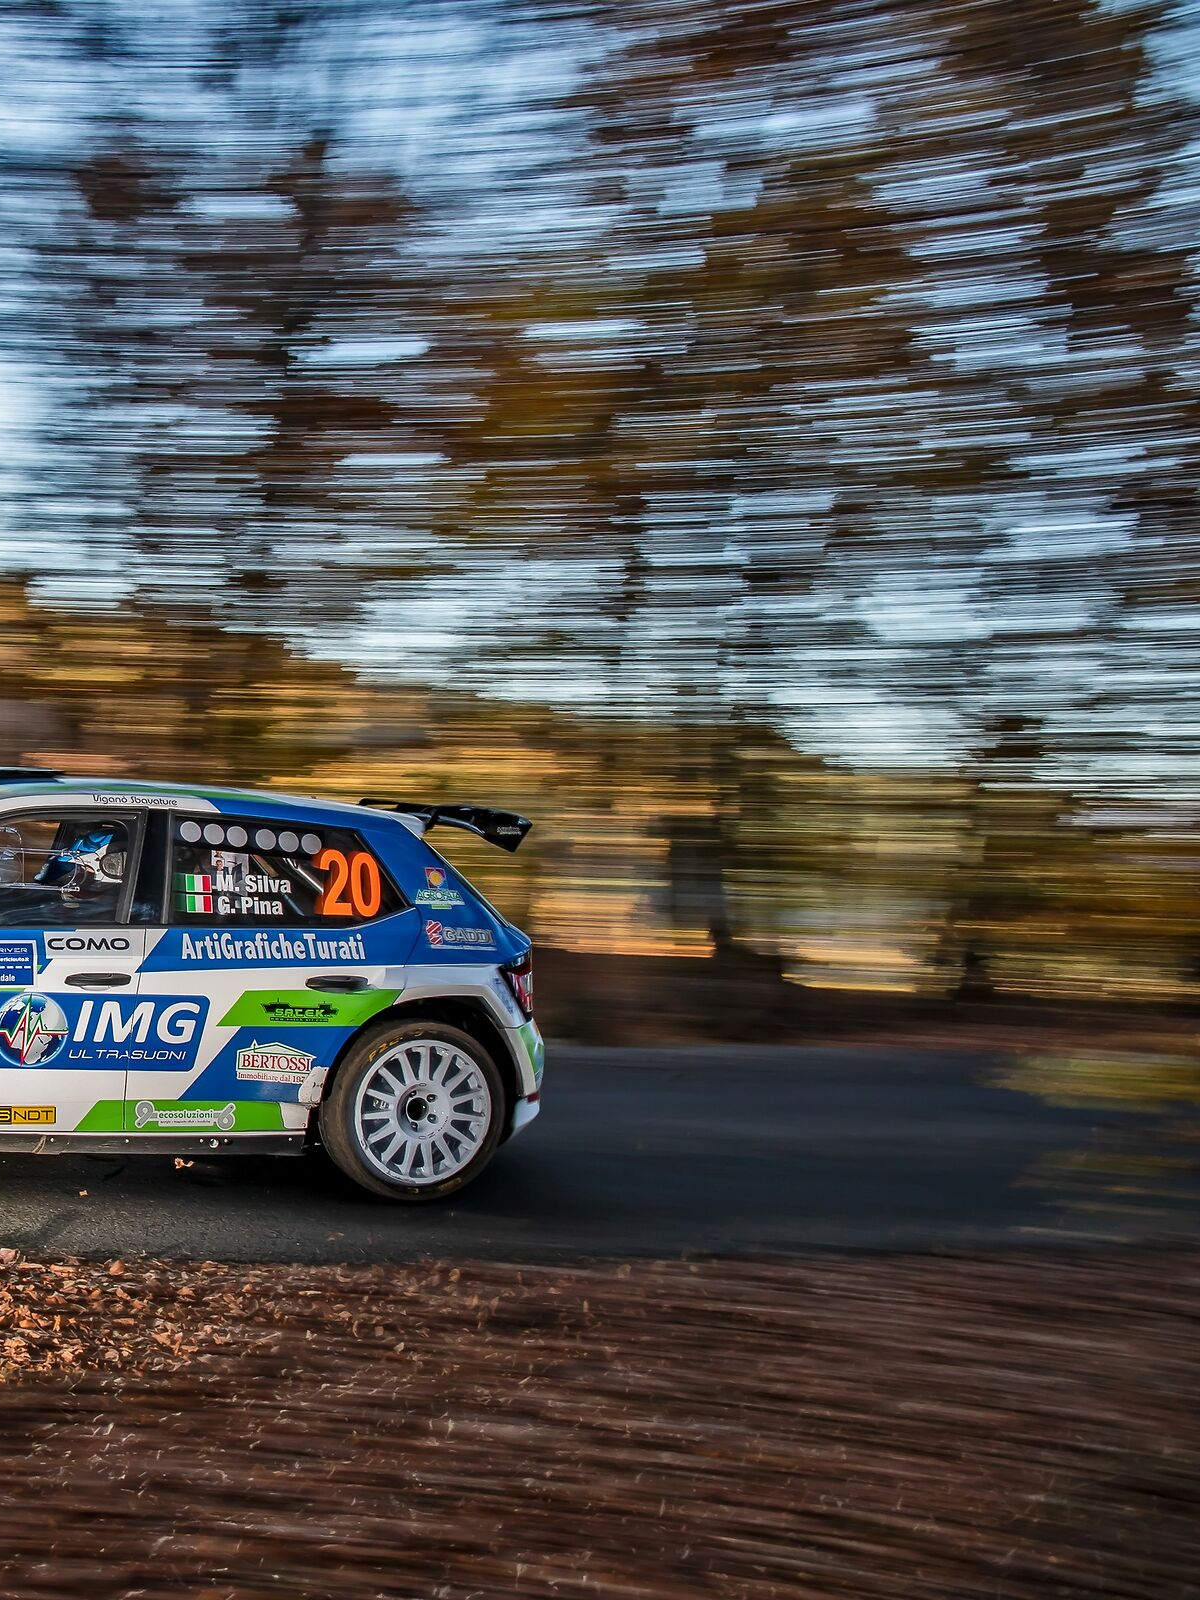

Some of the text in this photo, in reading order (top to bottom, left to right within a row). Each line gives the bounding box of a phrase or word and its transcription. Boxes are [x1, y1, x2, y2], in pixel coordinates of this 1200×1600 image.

[92, 794, 178, 806] Viganò Sbavature
[216, 874, 292, 894] M. Silva
[319, 849, 381, 917] 20
[217, 896, 284, 915] G. Pina
[47, 937, 130, 951] COMO
[443, 928, 496, 945] GADDI
[181, 932, 366, 960] ArtiGraficheTurati
[72, 1000, 201, 1044] IMG
[68, 1048, 187, 1061] ULTRASUONI
[241, 1054, 310, 1072] BERTOSSI
[158, 1110, 213, 1119] ecosoluzioni
